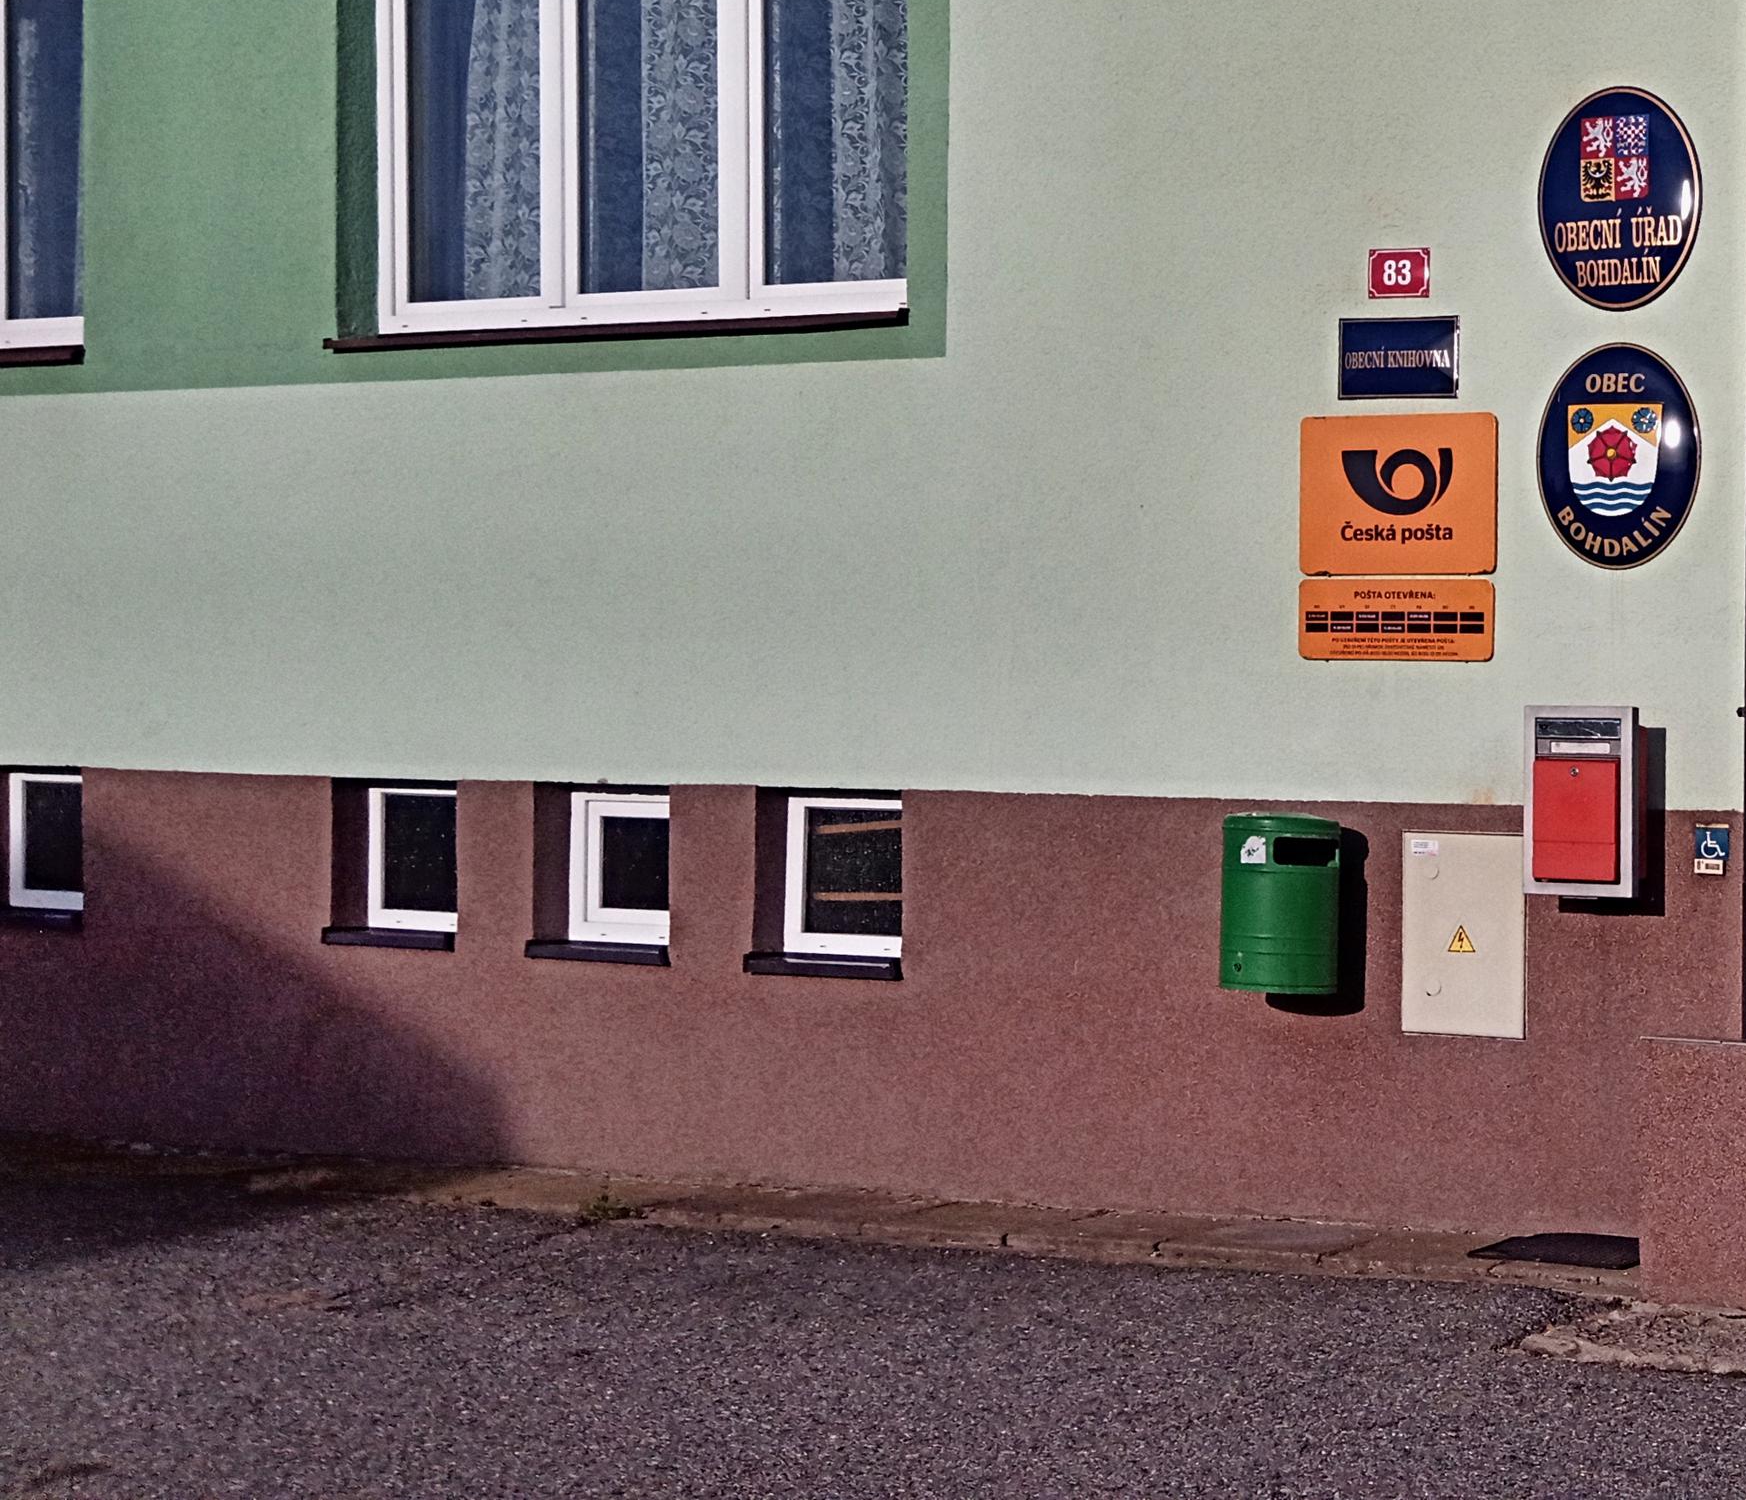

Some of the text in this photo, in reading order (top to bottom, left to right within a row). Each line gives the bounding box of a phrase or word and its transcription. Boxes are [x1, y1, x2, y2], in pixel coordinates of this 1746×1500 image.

[1554, 206, 1683, 253] OBECNÍ ÚŘAD
[1382, 259, 1412, 286] 83
[1575, 248, 1661, 288] BOHDALÍN
[1344, 345, 1451, 369] OBECNÍ KNIHOVNA
[1585, 372, 1646, 394] OBEC
[1340, 521, 1454, 545] Česká pošta
[1557, 505, 1673, 558] BOHDALÍN
[1353, 589, 1437, 600] POŠTA OTEVŘENA:
